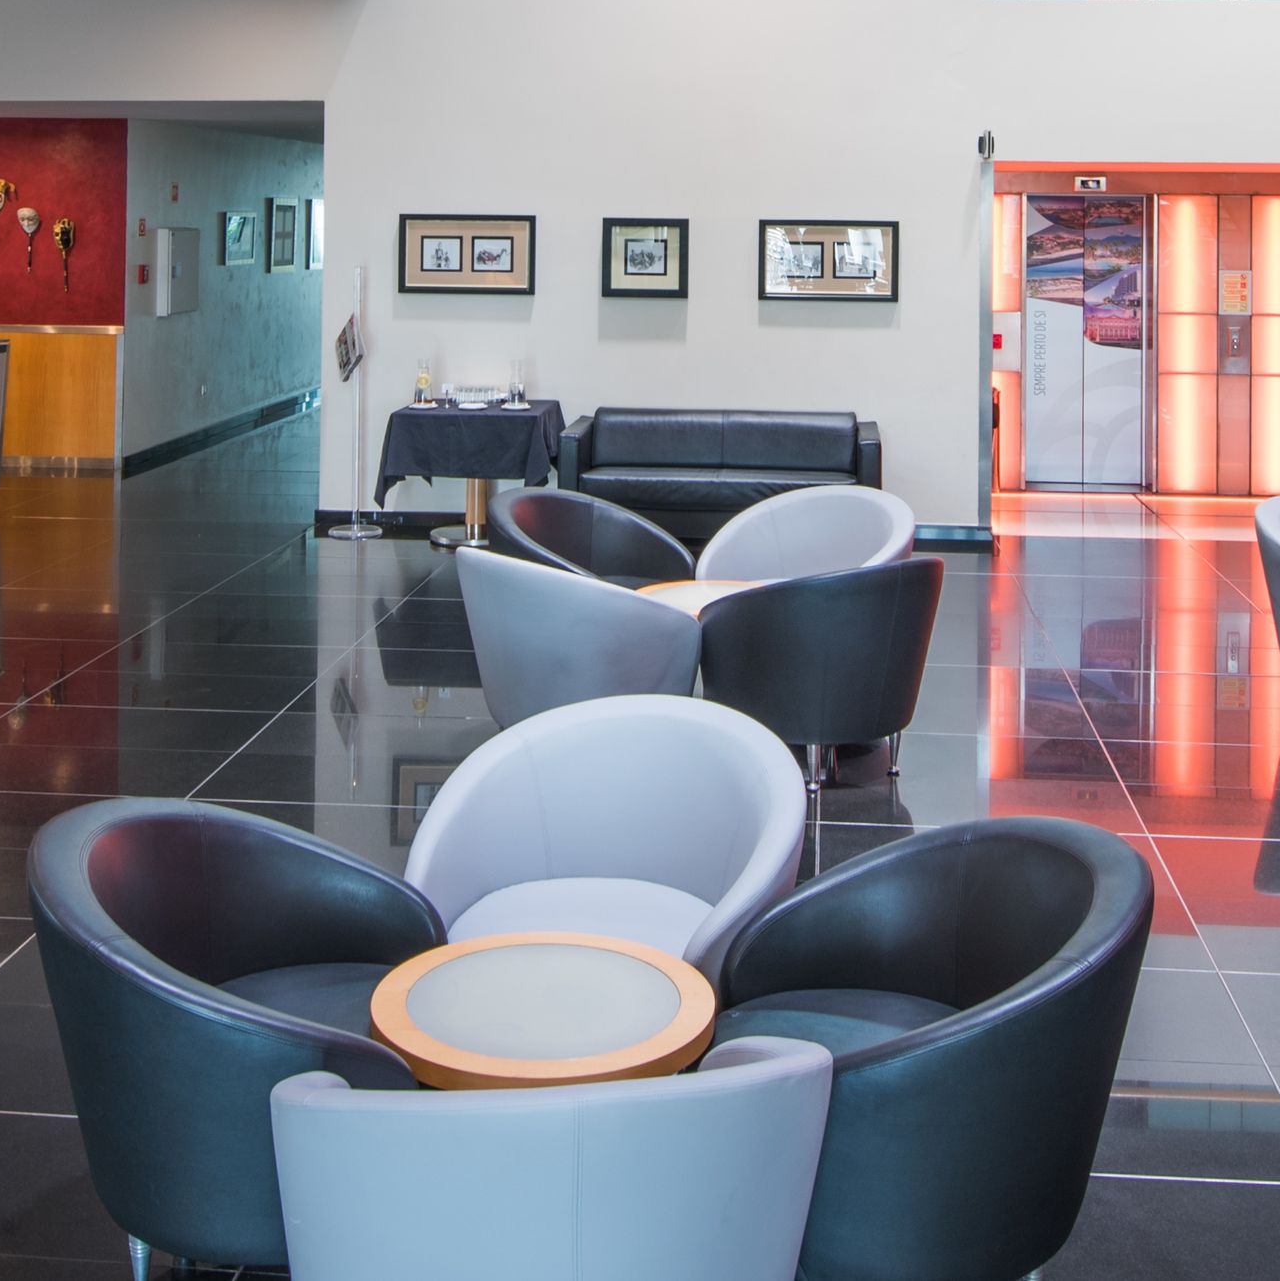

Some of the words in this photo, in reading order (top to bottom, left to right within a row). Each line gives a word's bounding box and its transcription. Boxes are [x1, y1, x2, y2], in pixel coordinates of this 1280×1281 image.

[1033, 310, 1046, 318] SI
[1033, 320, 1046, 332] DE
[1033, 333, 1046, 360] PERTO
[1033, 361, 1046, 396] SEMPRE
